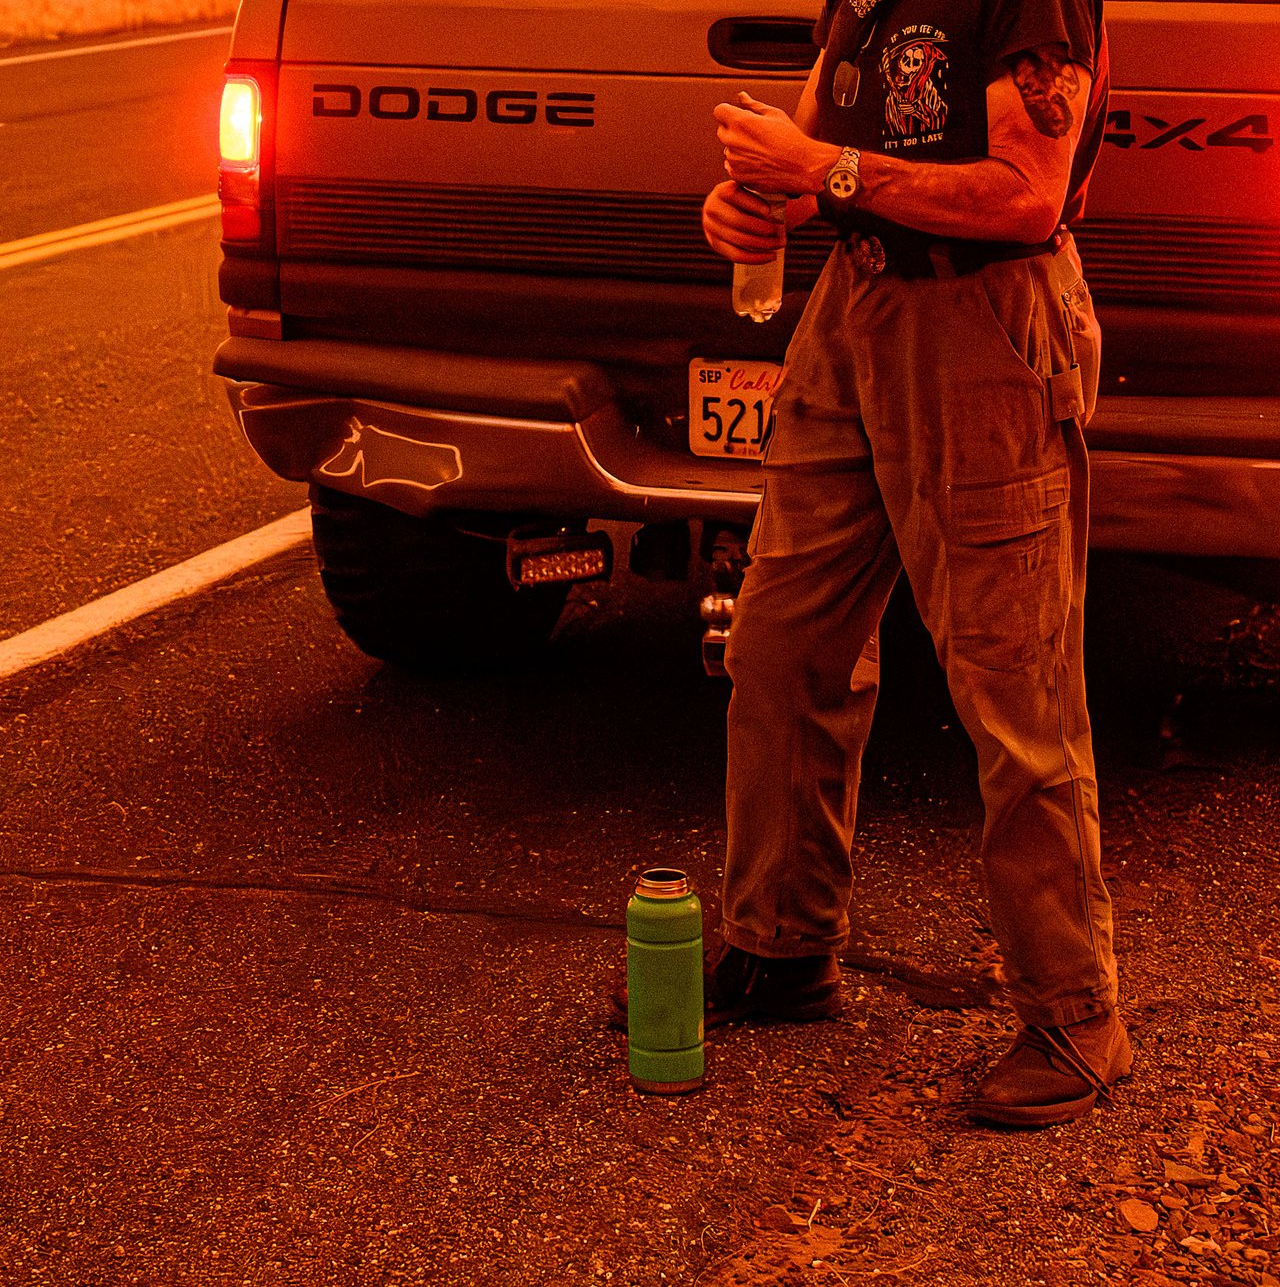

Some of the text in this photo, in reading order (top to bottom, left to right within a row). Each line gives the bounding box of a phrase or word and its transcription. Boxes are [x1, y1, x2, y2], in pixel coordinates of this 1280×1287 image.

[902, 24, 918, 35] YOU
[312, 83, 596, 127] DODGE
[902, 137, 917, 147] TOO
[921, 132, 944, 144] LATE
[699, 369, 722, 383] SEP
